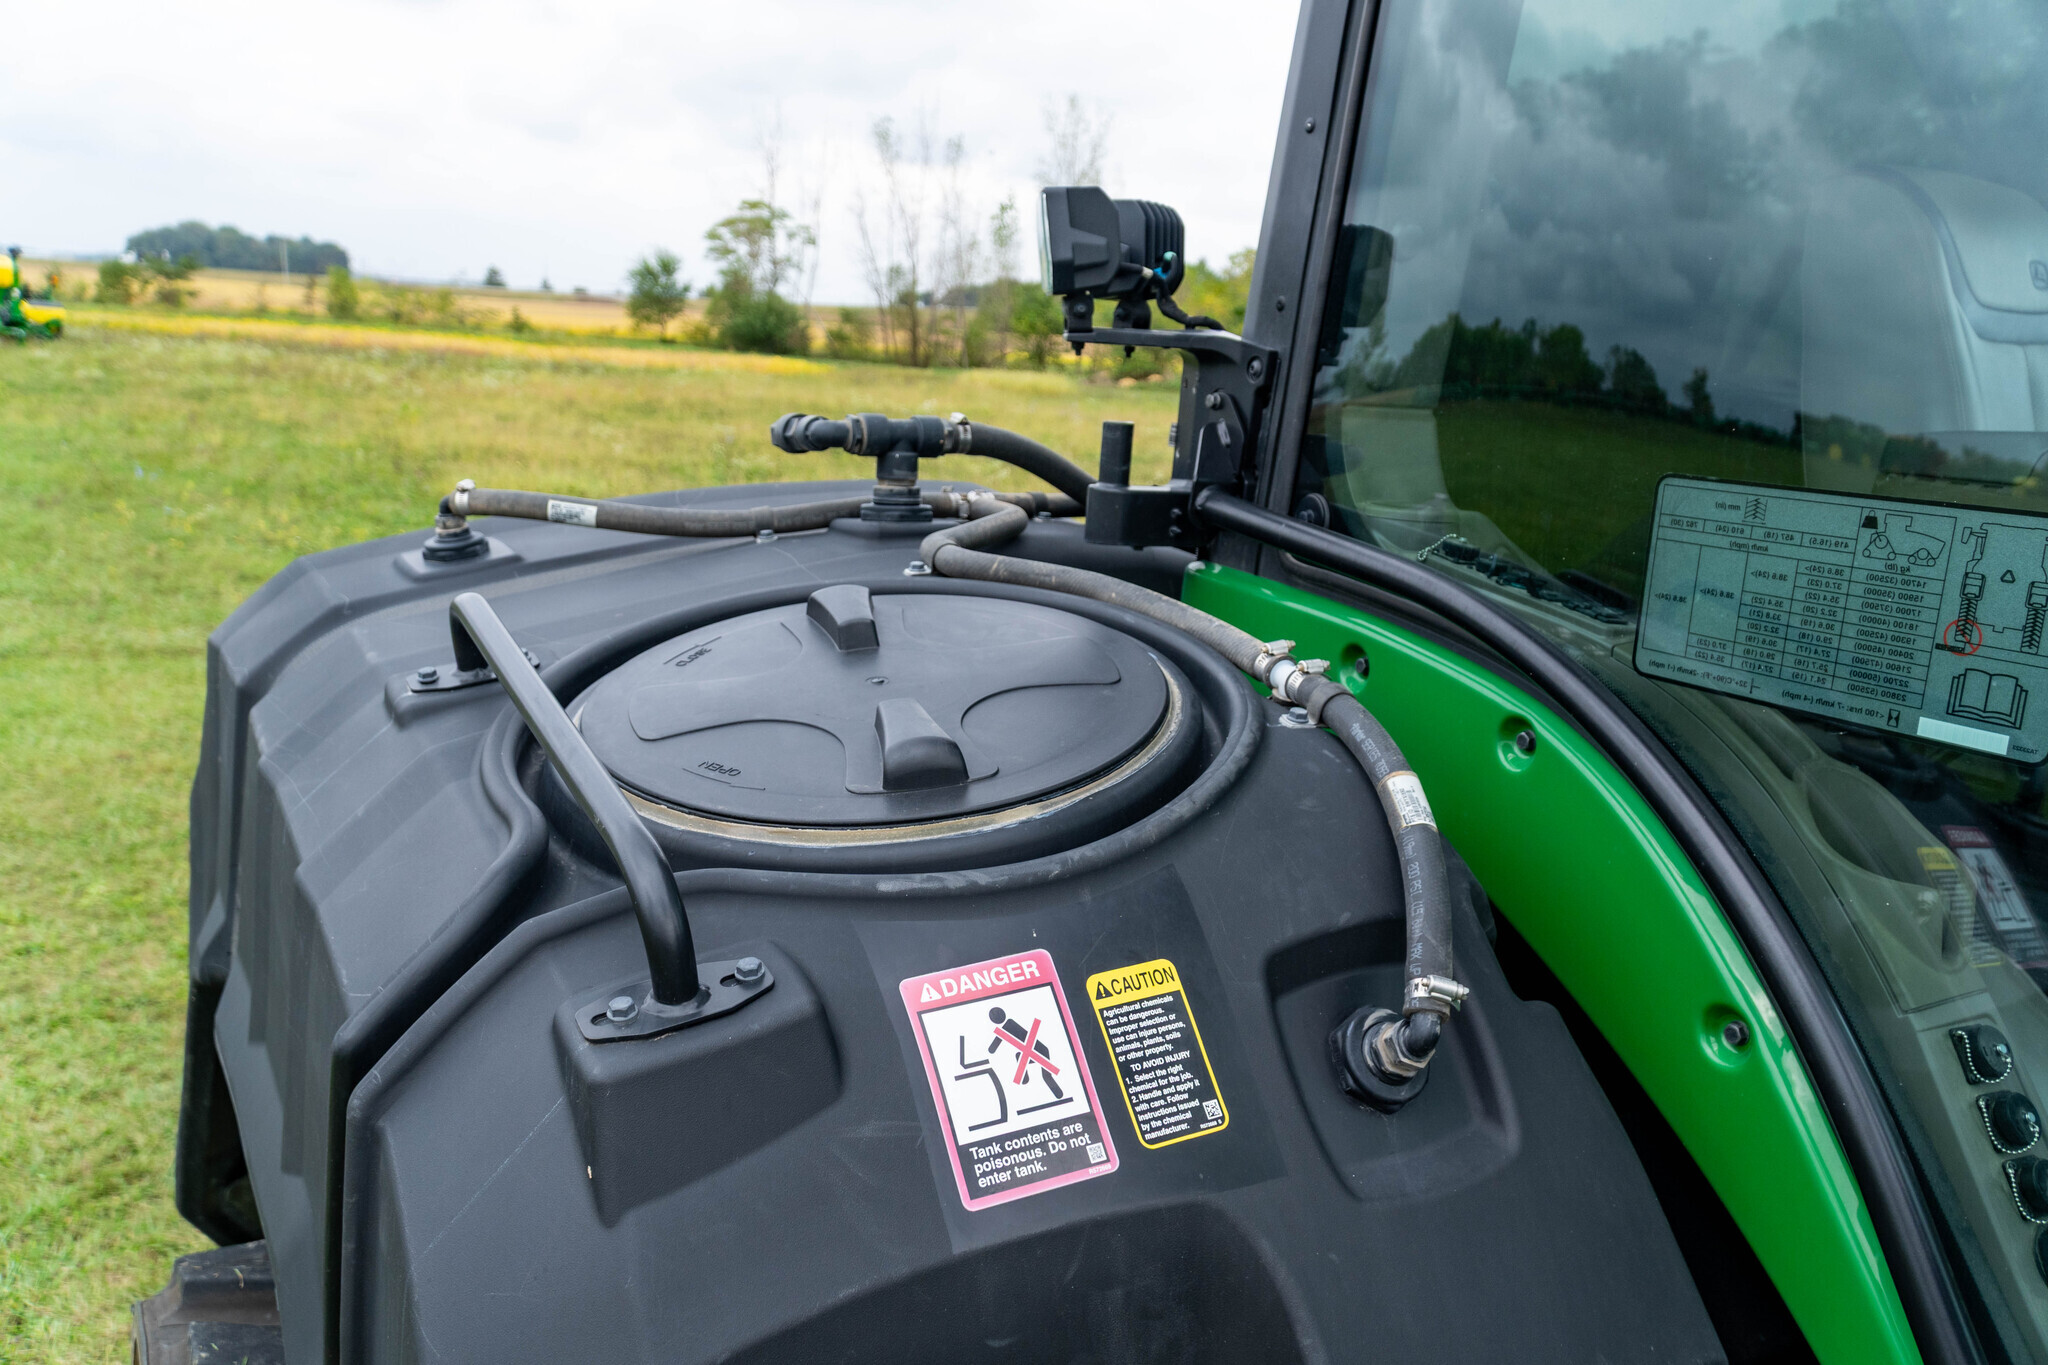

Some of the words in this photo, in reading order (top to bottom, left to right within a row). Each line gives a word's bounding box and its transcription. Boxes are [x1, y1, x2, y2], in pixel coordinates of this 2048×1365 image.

[1361, 738, 1381, 762] SERIES
[698, 761, 741, 776] OPEN
[1407, 861, 1420, 879] 200
[1410, 880, 1422, 896] PSI
[1410, 942, 1423, 961] MAX
[939, 960, 1040, 998] DANGER
[1111, 967, 1175, 995] CAUTION
[1103, 1002, 1141, 1018] Agricultural
[1141, 995, 1174, 1008] chemicals
[1106, 1018, 1119, 1026] can
[1128, 1007, 1165, 1021] dangerous.
[1108, 1023, 1138, 1035] Improper
[1139, 1016, 1169, 1028] selection
[1112, 1036, 1125, 1044] use
[1125, 1033, 1138, 1041] can
[1137, 1028, 1157, 1038] injure
[1157, 1021, 1186, 1034] persons,
[1115, 1041, 1143, 1053] animals,
[1143, 1036, 1166, 1048] plants,
[1165, 1031, 1181, 1041] soils
[1126, 1050, 1144, 1060] other
[1144, 1043, 1174, 1057] property.
[1130, 1063, 1142, 1072] TO
[1143, 1057, 1165, 1069] AVOID
[1164, 1050, 1190, 1063] INJURY
[1125, 1077, 1133, 1085] 1.
[1134, 1071, 1156, 1082] Select
[1155, 1069, 1167, 1077] the
[1167, 1064, 1184, 1074] right
[1128, 1080, 1159, 1094] chemical
[1158, 1078, 1168, 1086] for
[1168, 1075, 1180, 1083] the
[1180, 1072, 1194, 1082] job.
[1131, 1095, 1139, 1103] 2.
[1138, 1089, 1162, 1101] Handle
[1162, 1085, 1176, 1095] and
[1176, 1081, 1194, 1092] apply
[1134, 1102, 1150, 1112] with
[1150, 1099, 1167, 1108] care.
[1166, 1093, 1189, 1103] Follow
[1137, 1106, 1178, 1122] instructions
[1177, 1098, 1200, 1111] issued
[1140, 1123, 1150, 1132] by
[1150, 1120, 1162, 1128] the
[1162, 1110, 1192, 1125] chemical
[969, 1142, 1003, 1160] Tank
[1004, 1128, 1060, 1151] contents
[1062, 1123, 1083, 1136] are
[1144, 1123, 1190, 1140] manufacturer.
[974, 1148, 1047, 1177] poisonous.
[1048, 1141, 1067, 1154] Do
[1069, 1133, 1091, 1148] not
[978, 1170, 1012, 1188] enter
[1014, 1160, 1047, 1178] tank.
